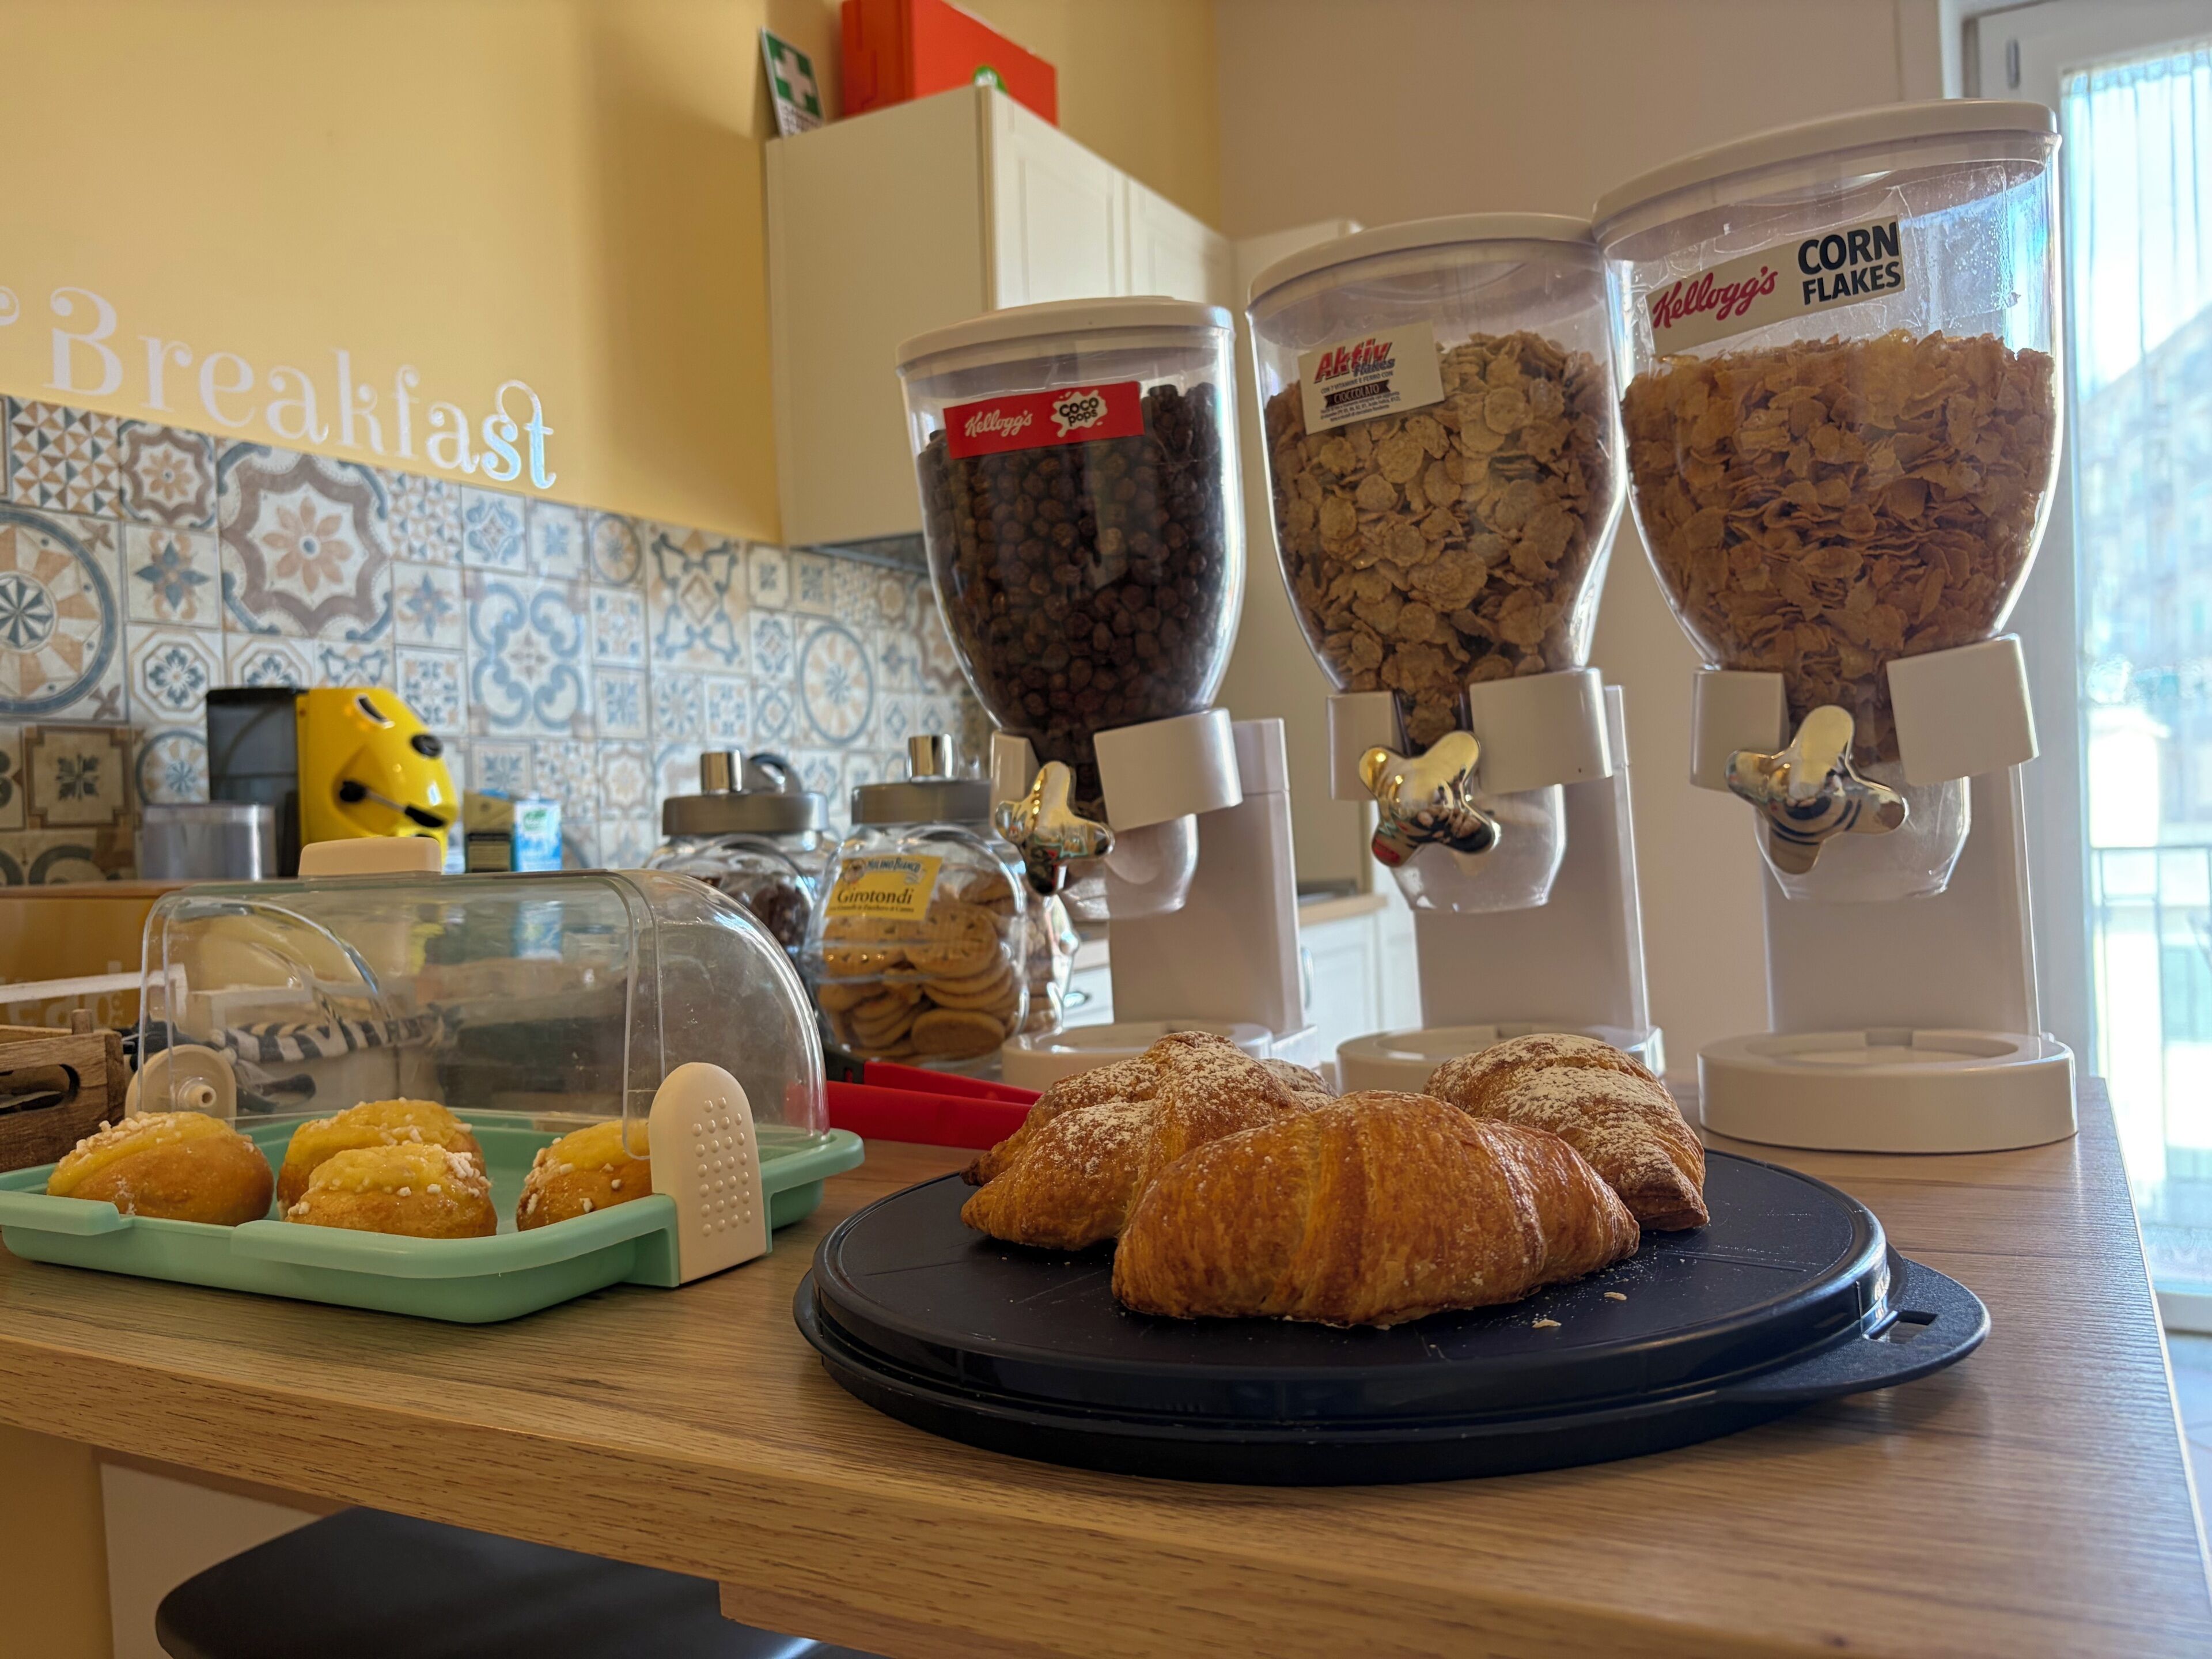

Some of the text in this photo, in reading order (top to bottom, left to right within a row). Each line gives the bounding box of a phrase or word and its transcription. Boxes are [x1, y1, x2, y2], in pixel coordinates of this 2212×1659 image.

[1798, 222, 1900, 275] CORN
[1653, 266, 1778, 329] Kellogg's
[1802, 261, 1902, 305] FLAKES
[1314, 338, 1393, 384] Aktiv
[43, 286, 556, 489] Breakfast
[1334, 384, 1380, 403] CIOCCOLATO
[965, 410, 1033, 438] Kellogg's
[1068, 409, 1098, 426] pops
[838, 888, 915, 905] Girotondi
